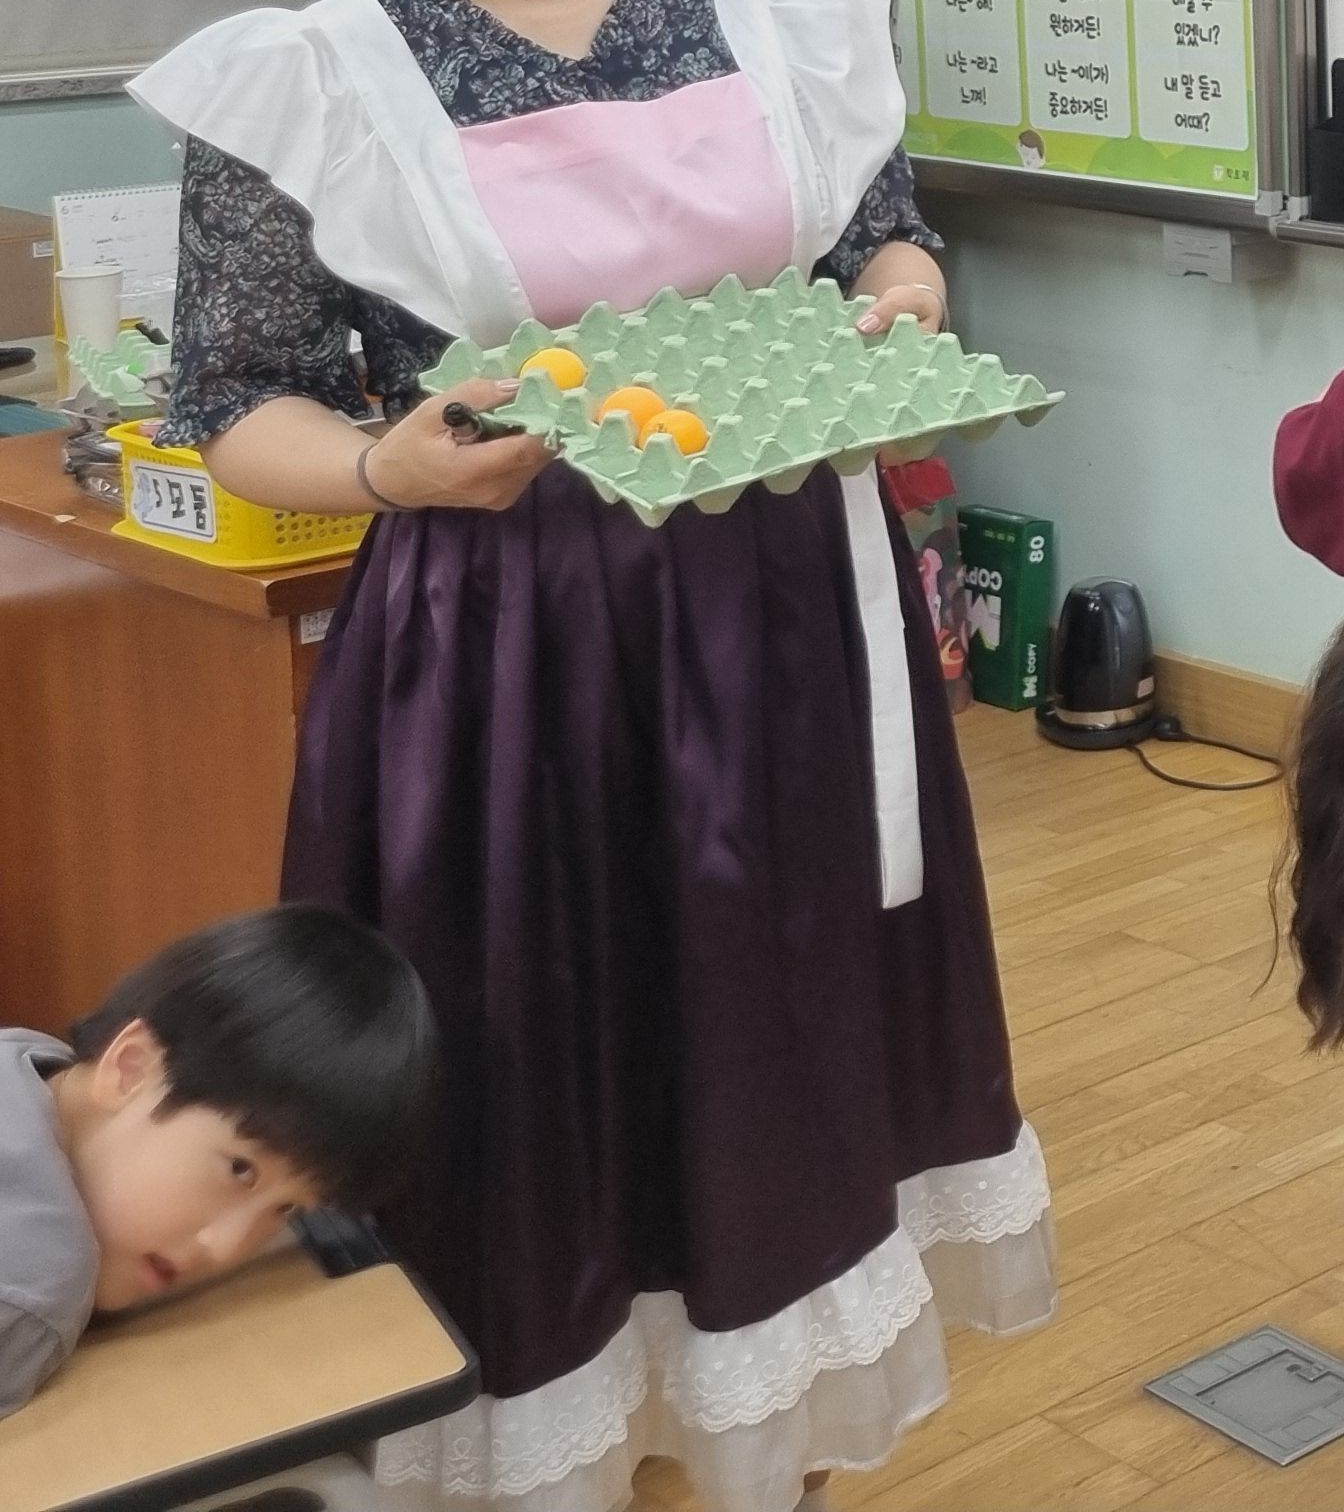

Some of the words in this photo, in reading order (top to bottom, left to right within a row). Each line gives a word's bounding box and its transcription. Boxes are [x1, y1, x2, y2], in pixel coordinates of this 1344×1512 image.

[1049, 14, 1101, 39] 원하거든!
[1174, 24, 1220, 47] 있겠니?
[946, 51, 967, 72] 나는
[1044, 61, 1069, 84] 나는
[1164, 75, 1178, 94] 내
[1182, 74, 1194, 100] 말
[1199, 75, 1222, 101] 듣고
[1048, 93, 1108, 121] 중요하거든!
[1175, 112, 1210, 133] 어때?
